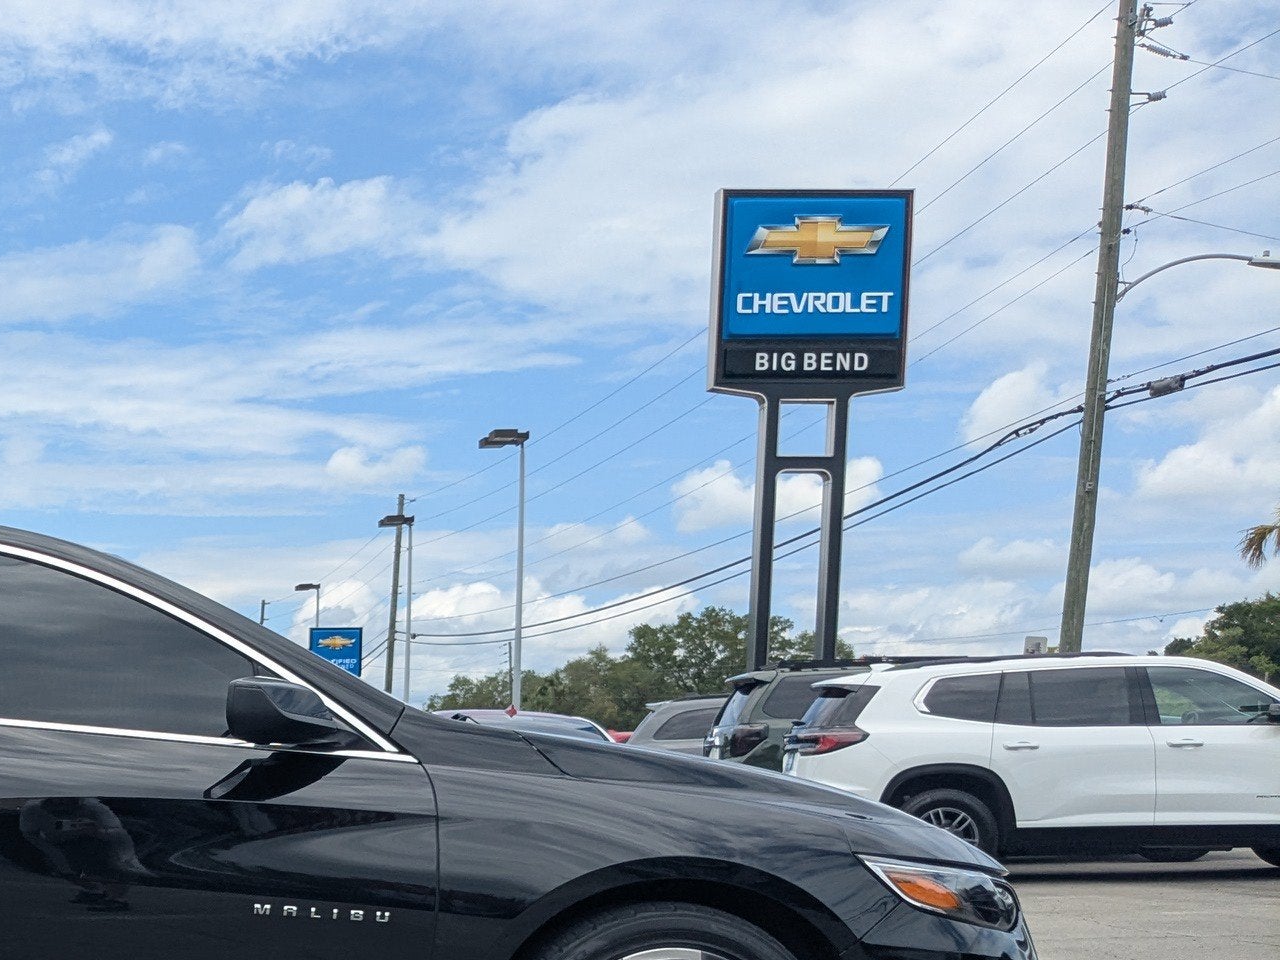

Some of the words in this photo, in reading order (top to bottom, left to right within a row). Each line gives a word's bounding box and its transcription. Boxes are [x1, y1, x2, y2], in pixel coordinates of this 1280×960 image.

[736, 291, 894, 314] CHEVROLET
[755, 352, 796, 371] BIG
[803, 352, 869, 371] BEND
[253, 903, 391, 923] MALIBU
